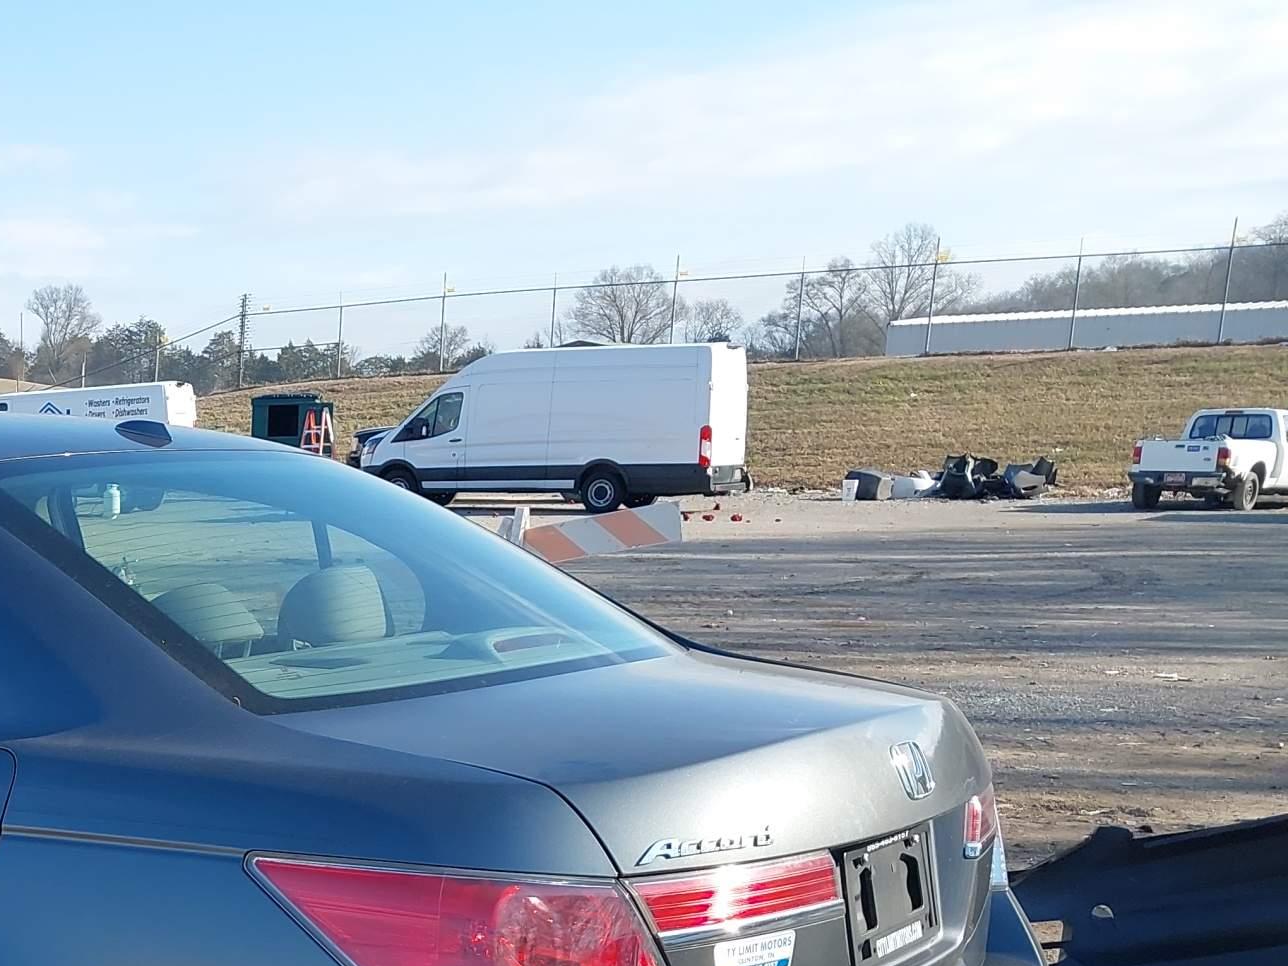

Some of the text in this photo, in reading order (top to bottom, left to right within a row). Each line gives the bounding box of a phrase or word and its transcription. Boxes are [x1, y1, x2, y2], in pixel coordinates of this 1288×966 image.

[88, 399, 110, 407] Washers
[115, 396, 150, 406] Refrigerators
[115, 408, 148, 417] Dishwashers
[633, 825, 774, 867] Accord
[738, 943, 758, 955] LIMIT
[760, 936, 792, 951] MOTORS
